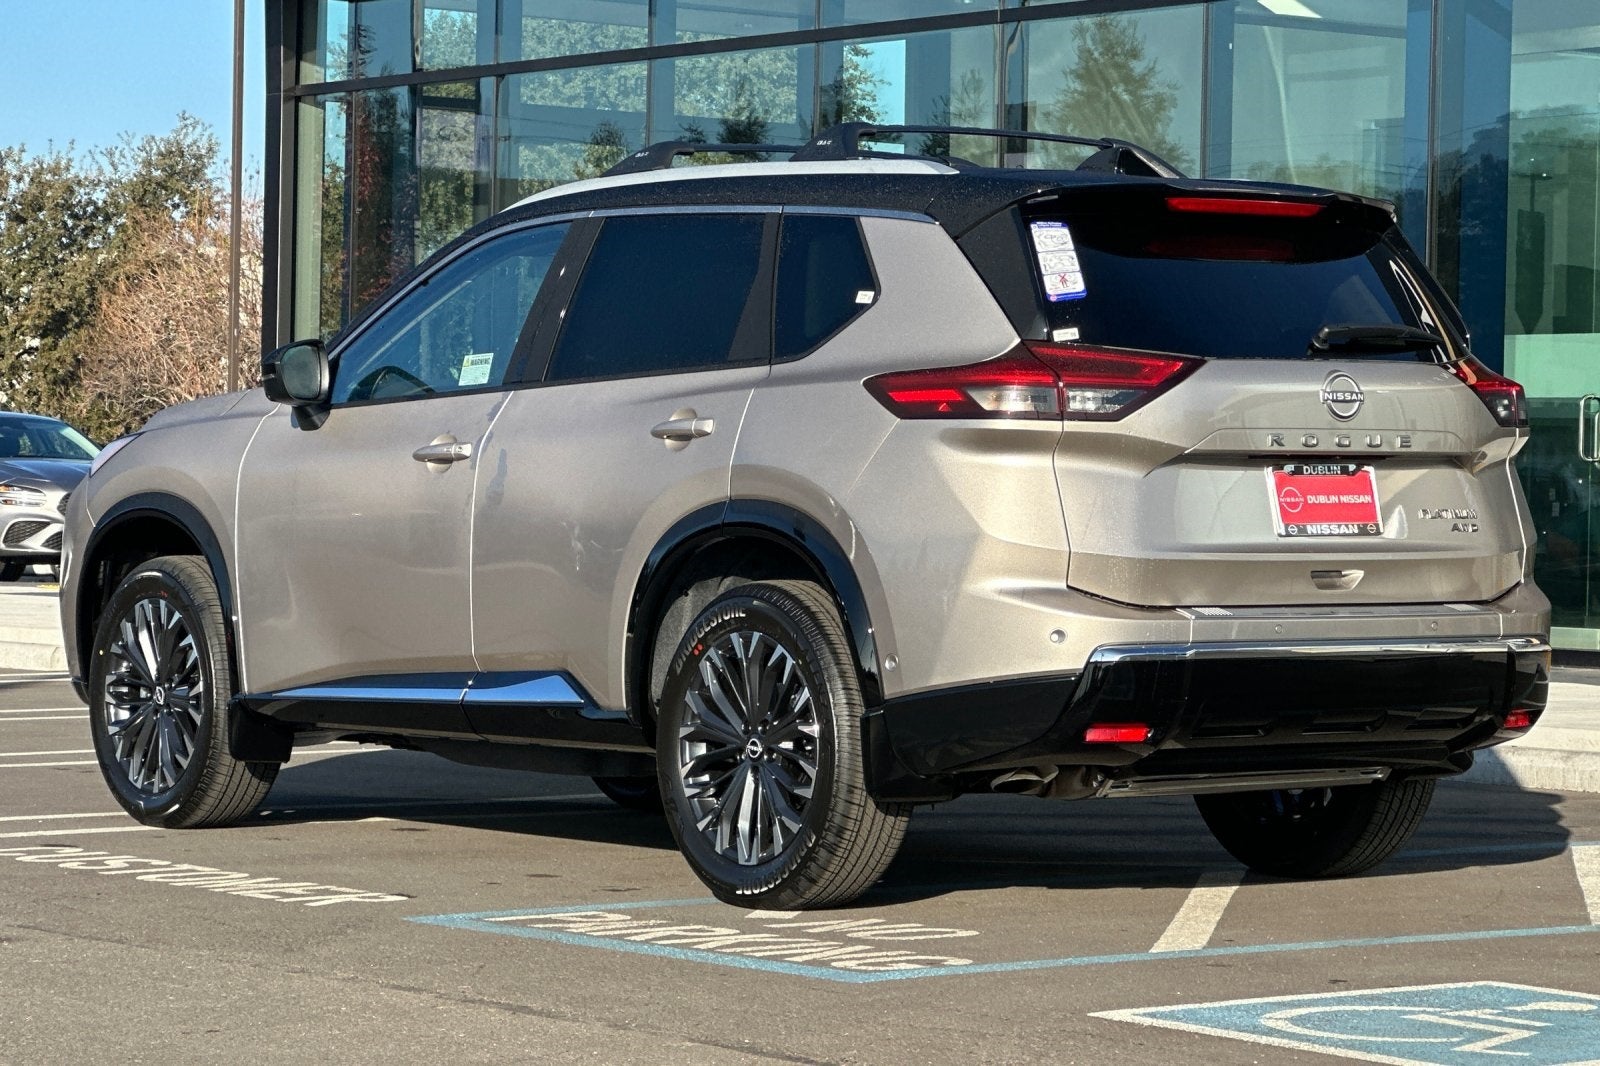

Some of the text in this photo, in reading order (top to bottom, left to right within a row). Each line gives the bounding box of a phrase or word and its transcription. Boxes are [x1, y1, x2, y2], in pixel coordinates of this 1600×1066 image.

[1323, 391, 1364, 401] NISSAN
[1267, 433, 1412, 448] ROGUE
[1303, 464, 1341, 475] DUBLIN
[1307, 494, 1372, 504] DUBLIN NISSAN
[1306, 524, 1359, 534] NISSAN
